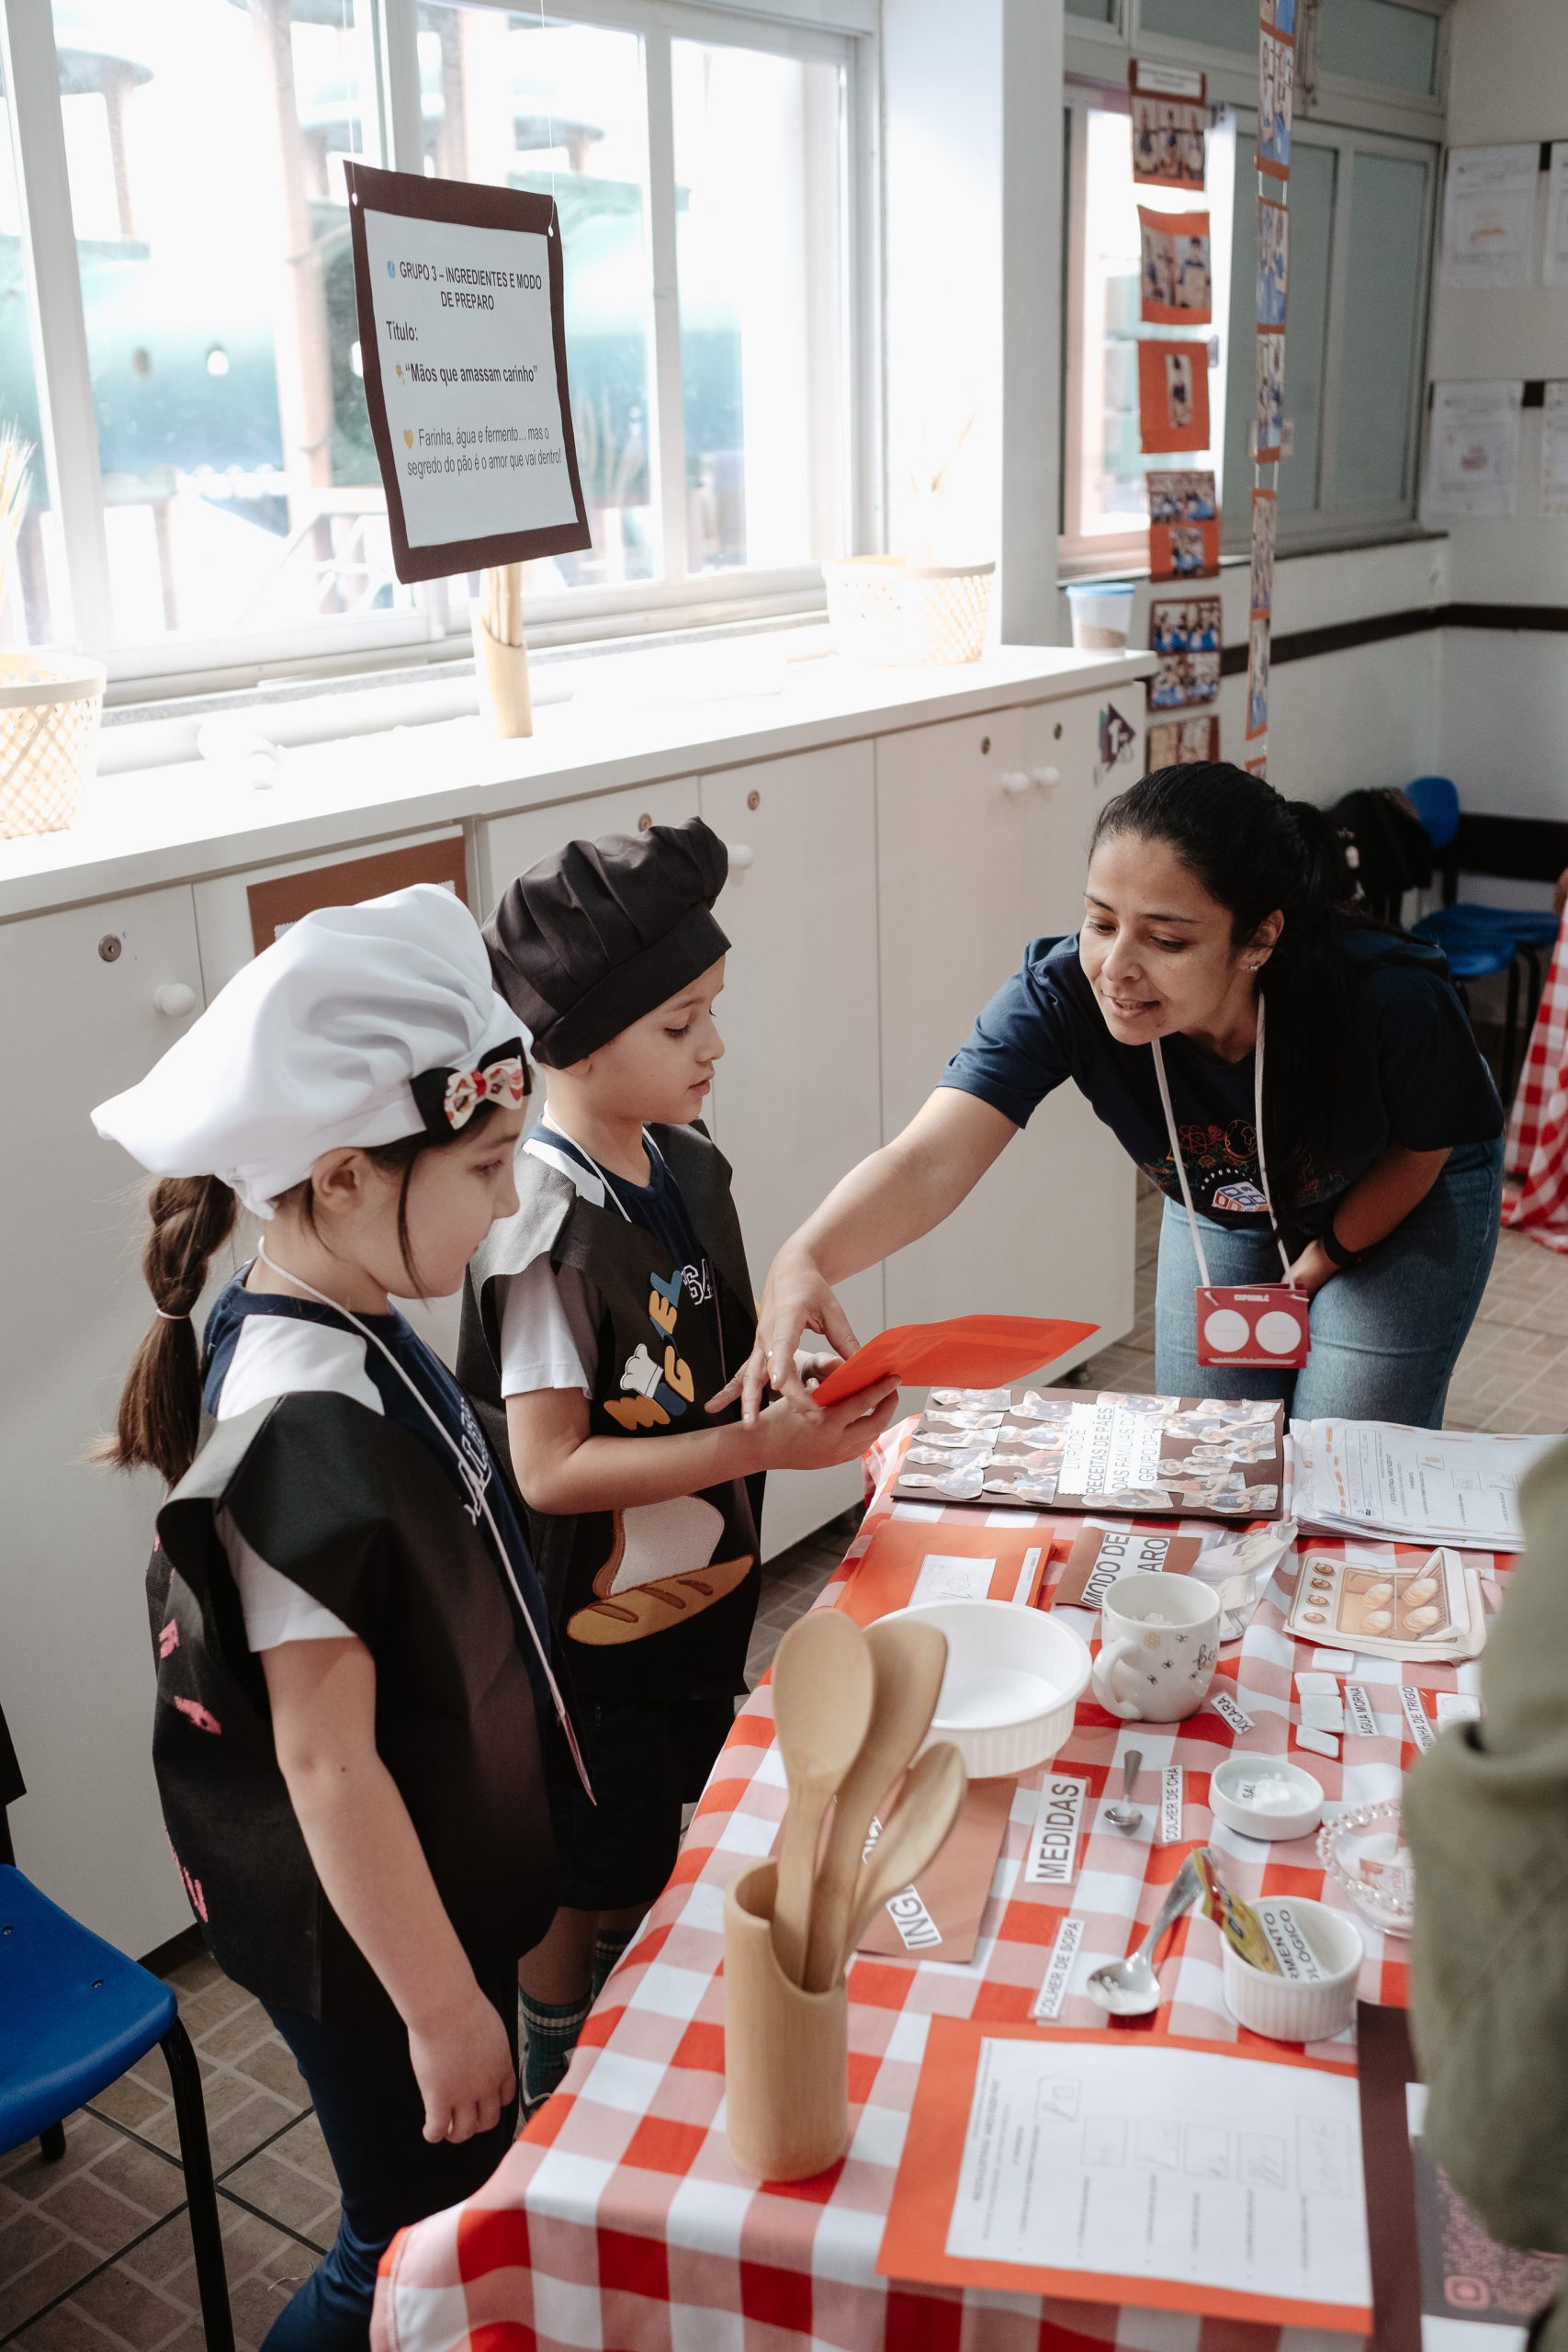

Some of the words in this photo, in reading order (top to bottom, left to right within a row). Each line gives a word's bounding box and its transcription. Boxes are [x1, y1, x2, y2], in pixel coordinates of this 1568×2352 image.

[400, 261, 430, 281] GRUPO
[431, 265, 437, 281] 3
[446, 266, 508, 288] INGREDIENTES
[509, 273, 515, 288] E
[516, 275, 542, 290] MODO
[440, 291, 454, 308] DE
[455, 292, 495, 311] PREPARO
[386, 321, 419, 342] Título:
[405, 363, 438, 382] “Mãos
[439, 368, 457, 387] que
[461, 368, 502, 382] amassam
[502, 364, 537, 382] carinho”
[418, 427, 455, 447] Farinha,
[456, 427, 476, 449] água
[478, 431, 483, 443] e
[527, 427, 543, 441] mas
[544, 428, 549, 440] o
[407, 456, 443, 480] segredo
[444, 456, 456, 473] do
[457, 455, 472, 476] pão
[474, 453, 479, 471] é
[481, 458, 487, 469] o
[489, 455, 507, 469] amor
[509, 454, 524, 471] que
[525, 449, 536, 467] vai
[537, 447, 562, 465] dentro!
[1092, 1407, 1113, 1432] PÃES
[1120, 1411, 1137, 1426] DO
[1068, 1428, 1087, 1442] DE
[1093, 1435, 1110, 1447] DE
[1065, 1443, 1084, 1470] LIVRO
[1139, 1448, 1158, 1482] GRUPO
[1086, 1449, 1108, 1494] RECEITAS
[1111, 1469, 1131, 1489] DAS
[1100, 1533, 1130, 1557] DE
[1136, 1538, 1168, 1574] ARO
[1082, 1560, 1122, 1607] MODO
[1349, 1687, 1367, 1713] MORNA
[1402, 1686, 1419, 1712] TRIGO
[1217, 1696, 1253, 1731] XÍCARA
[1411, 1713, 1425, 1724] DE
[1167, 1788, 1179, 1801] DE
[1035, 1782, 1080, 1880] MEDIDAS
[1166, 1802, 1179, 1840] COLHER
[1059, 1922, 1080, 1952] SOPA
[1054, 1953, 1070, 1971] DE
[1039, 1971, 1064, 2014] COLHER
